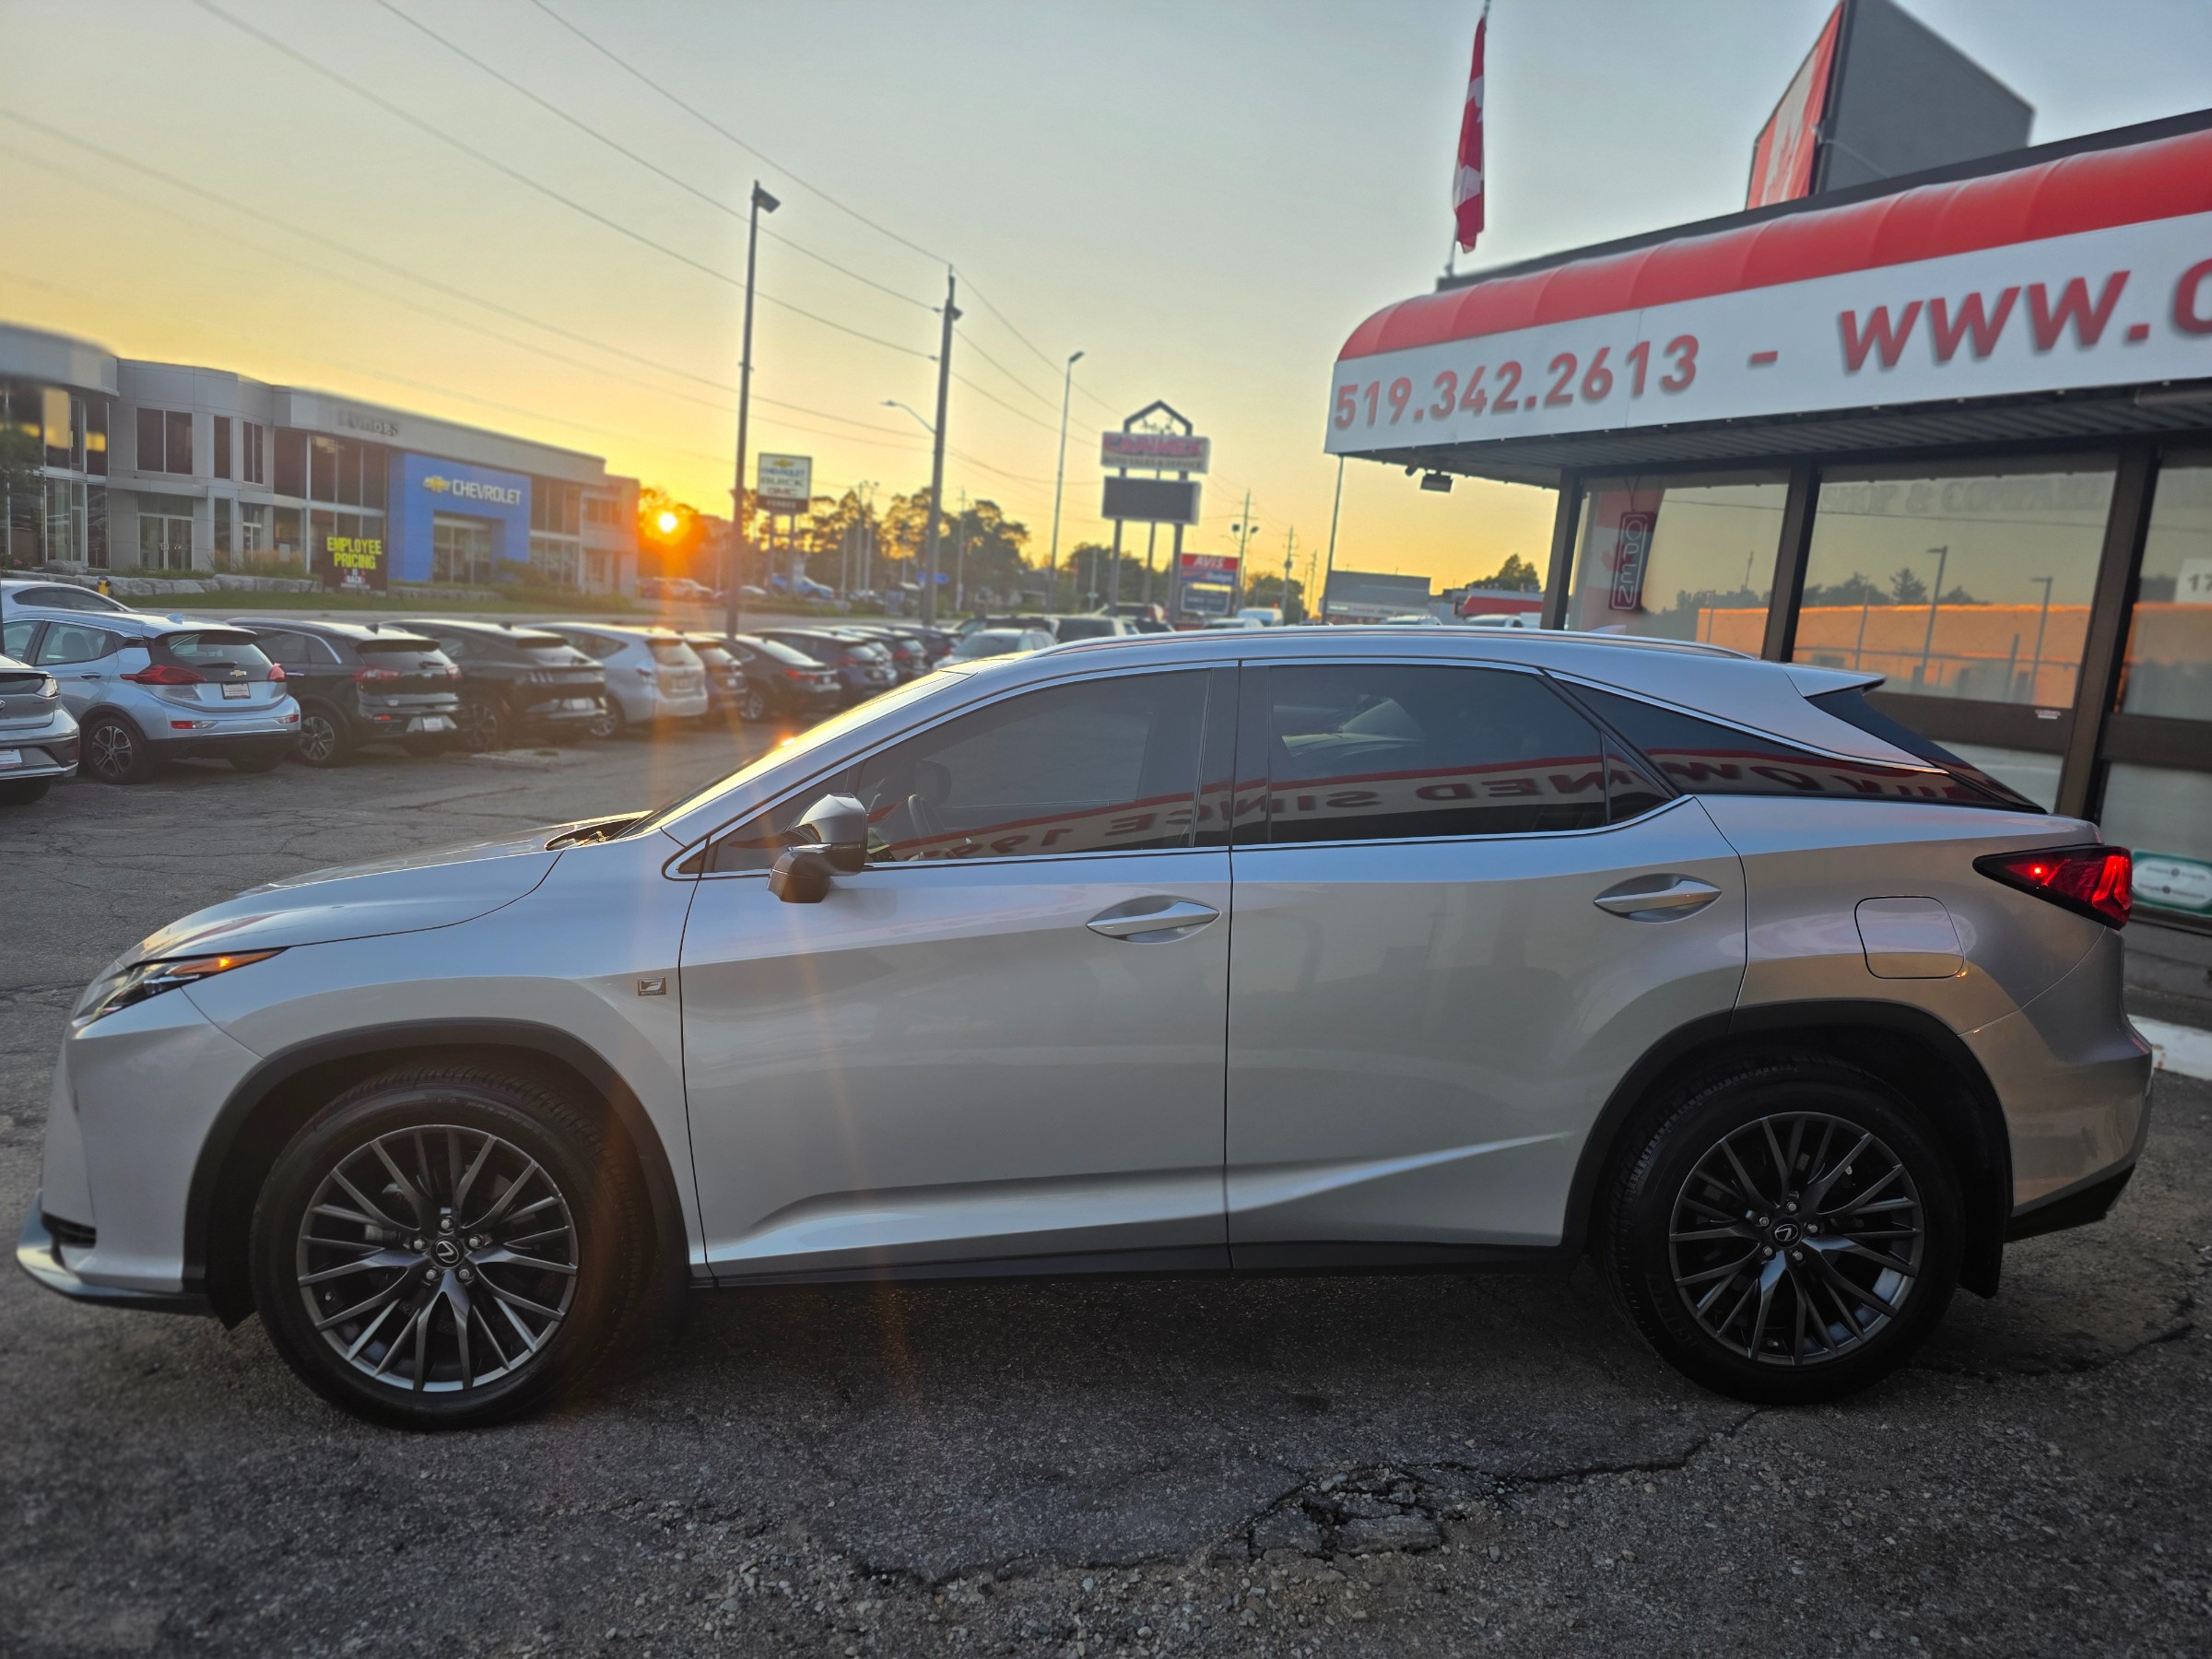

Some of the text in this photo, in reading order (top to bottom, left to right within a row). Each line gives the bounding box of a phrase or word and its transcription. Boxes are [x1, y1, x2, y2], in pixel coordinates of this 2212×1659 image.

[1334, 334, 1700, 429] 519.342.2613
[453, 479, 522, 505] CHEVROLET
[326, 536, 382, 555] EMPLOYEE
[334, 553, 376, 570] PRICING
[1194, 555, 1224, 570] AVIS
[1618, 520, 1643, 604] OPEN
